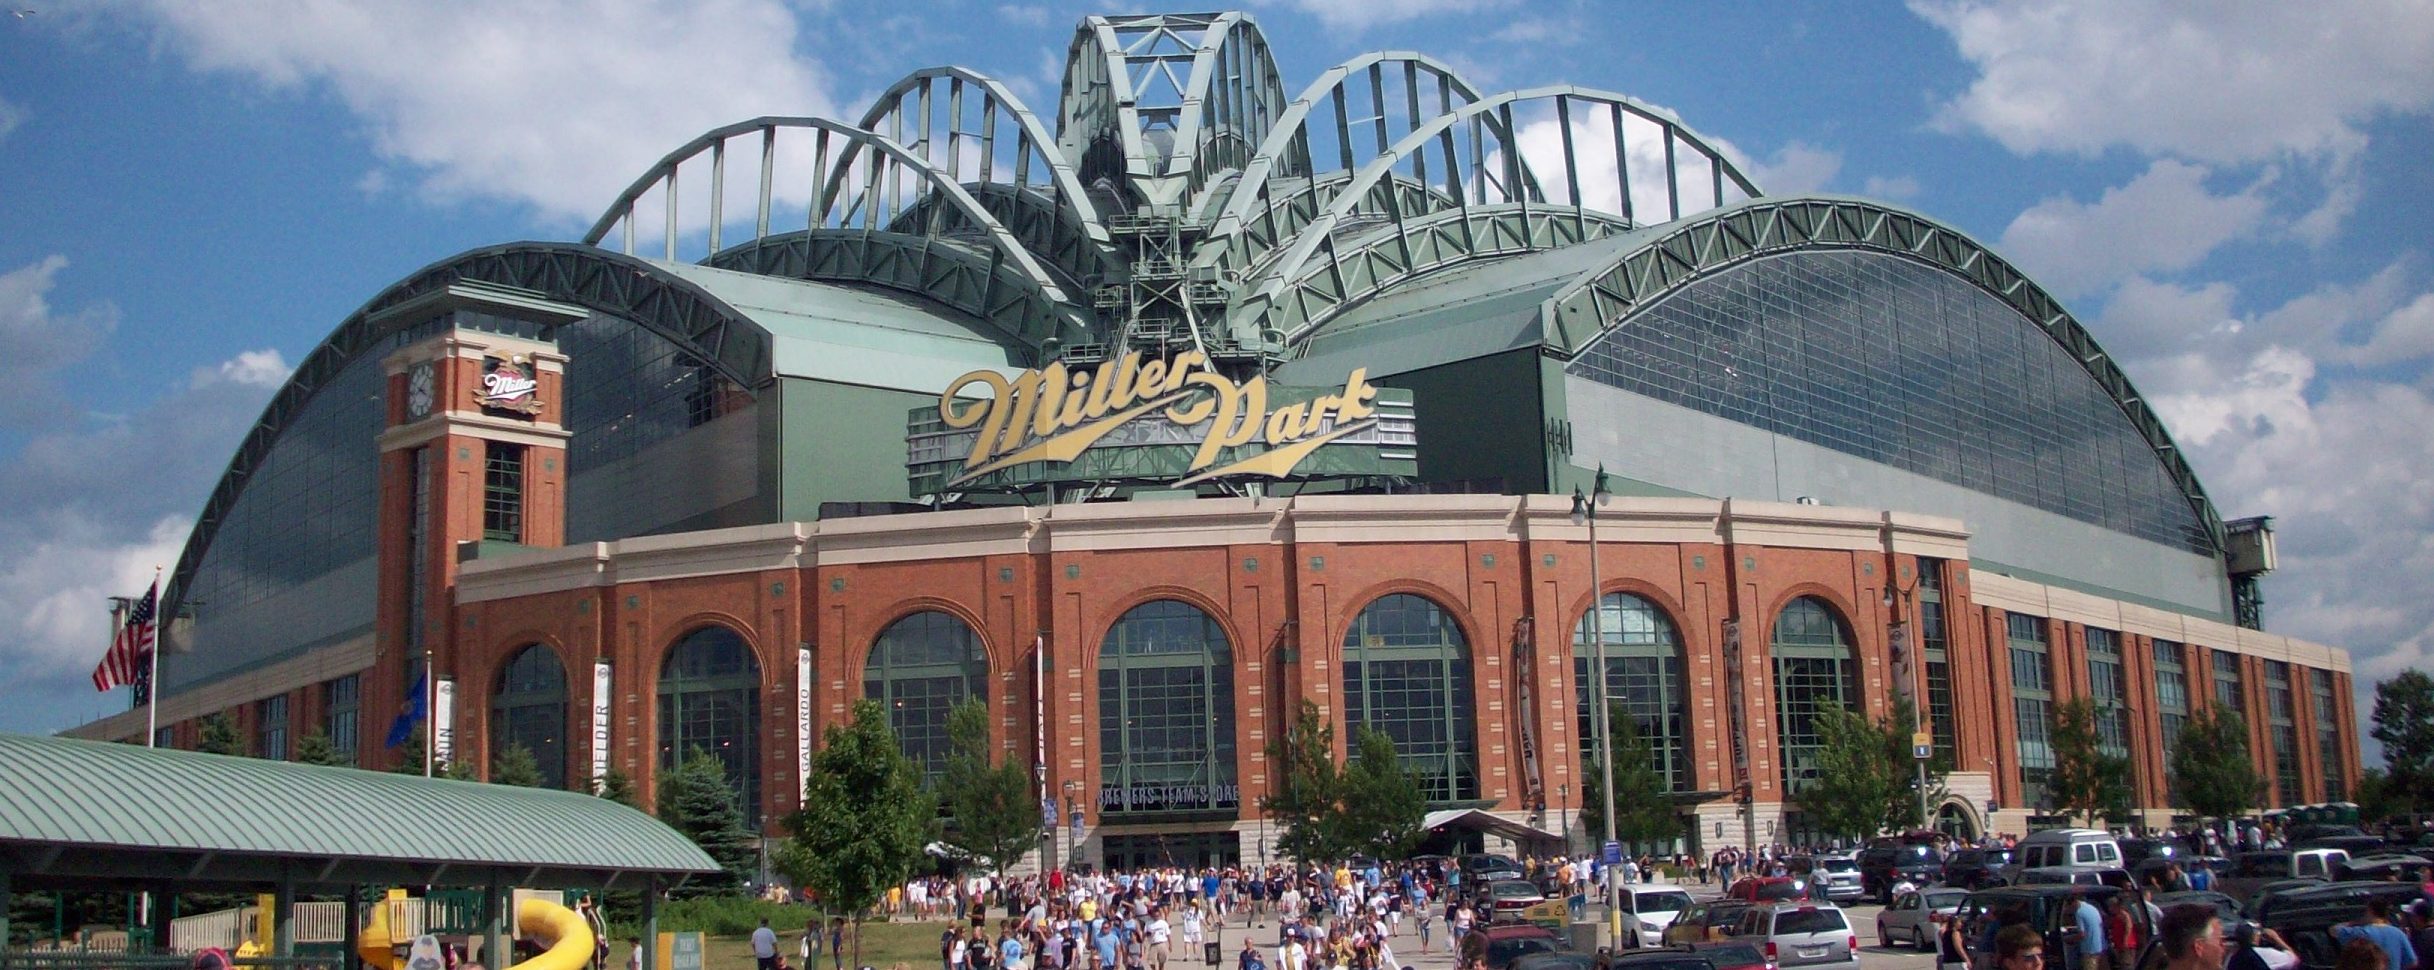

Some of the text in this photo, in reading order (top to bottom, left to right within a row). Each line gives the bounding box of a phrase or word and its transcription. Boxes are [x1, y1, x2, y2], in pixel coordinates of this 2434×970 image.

[485, 373, 537, 396] Miller
[941, 349, 1378, 474] Miller Park
[595, 705, 608, 776] IELDER
[800, 689, 810, 772] GALLARDO
[1097, 786, 1155, 805] BREWERS
[1160, 785, 1195, 803] TEAM
